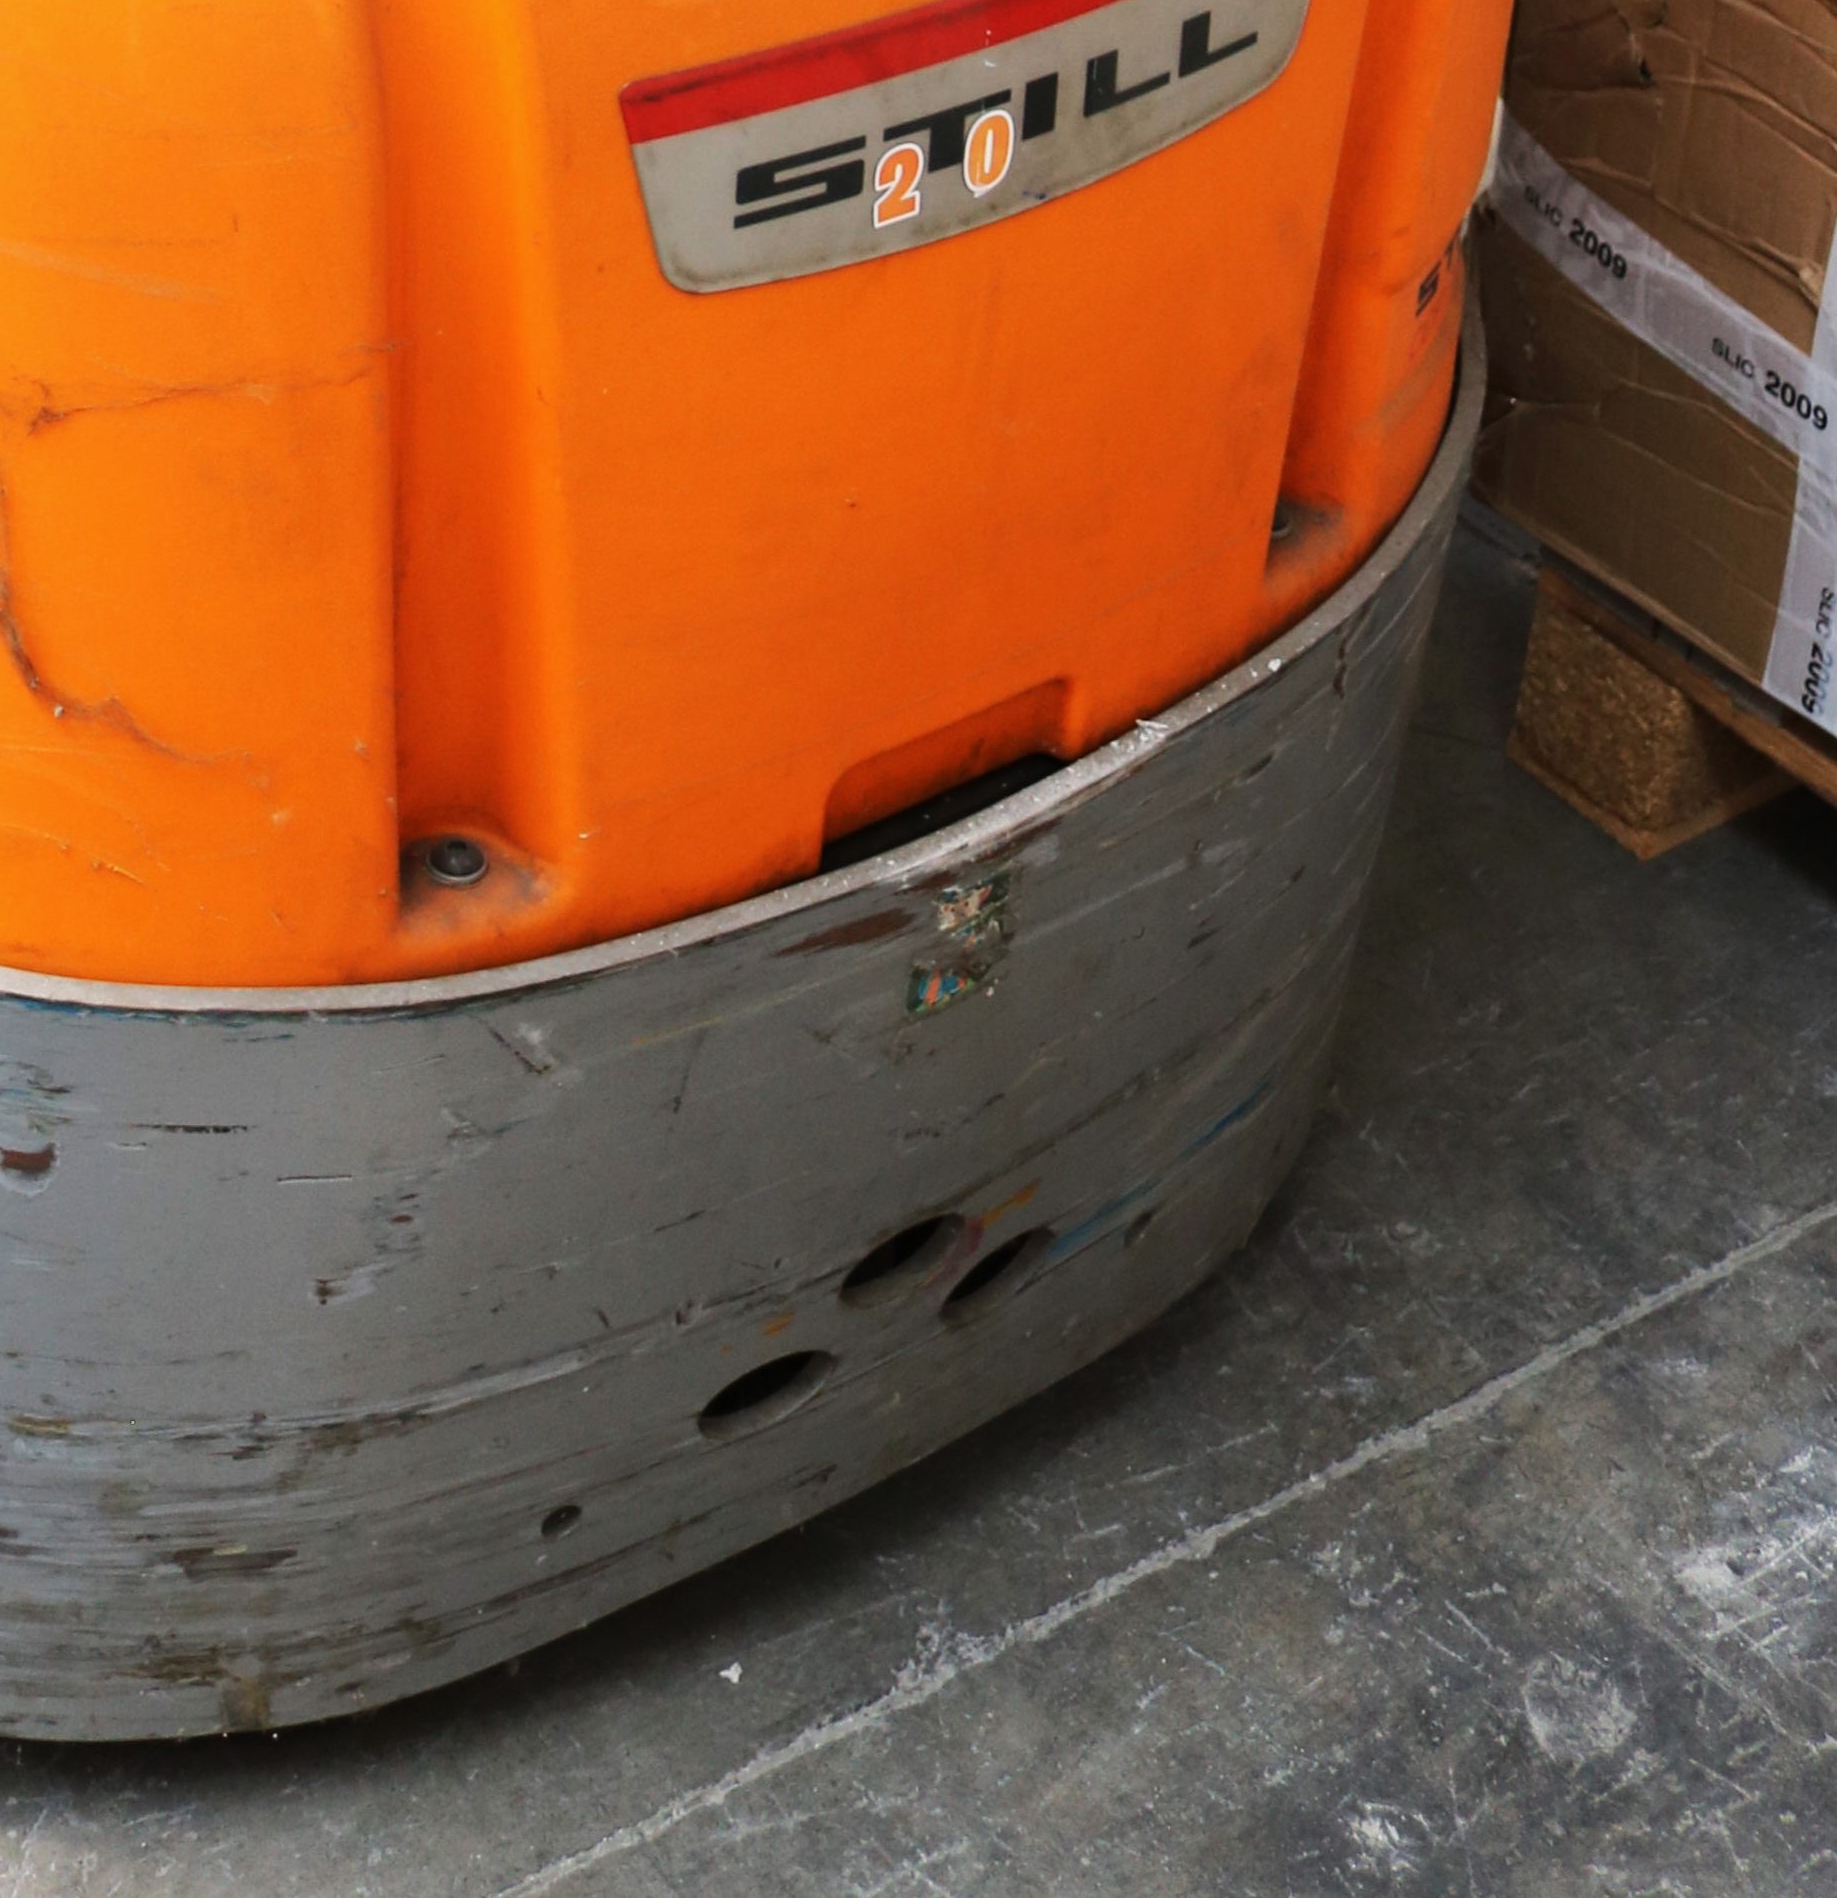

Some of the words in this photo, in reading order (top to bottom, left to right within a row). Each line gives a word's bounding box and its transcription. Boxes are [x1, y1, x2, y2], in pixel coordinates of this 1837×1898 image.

[733, 10, 1258, 230] STILL
[1525, 185, 1562, 228] SLIC
[1569, 217, 1628, 280] 2009
[1711, 337, 1755, 378] SLIC
[1765, 369, 1828, 431] 2009
[1815, 587, 1835, 639] SLIC
[1802, 642, 1833, 718] 2009
